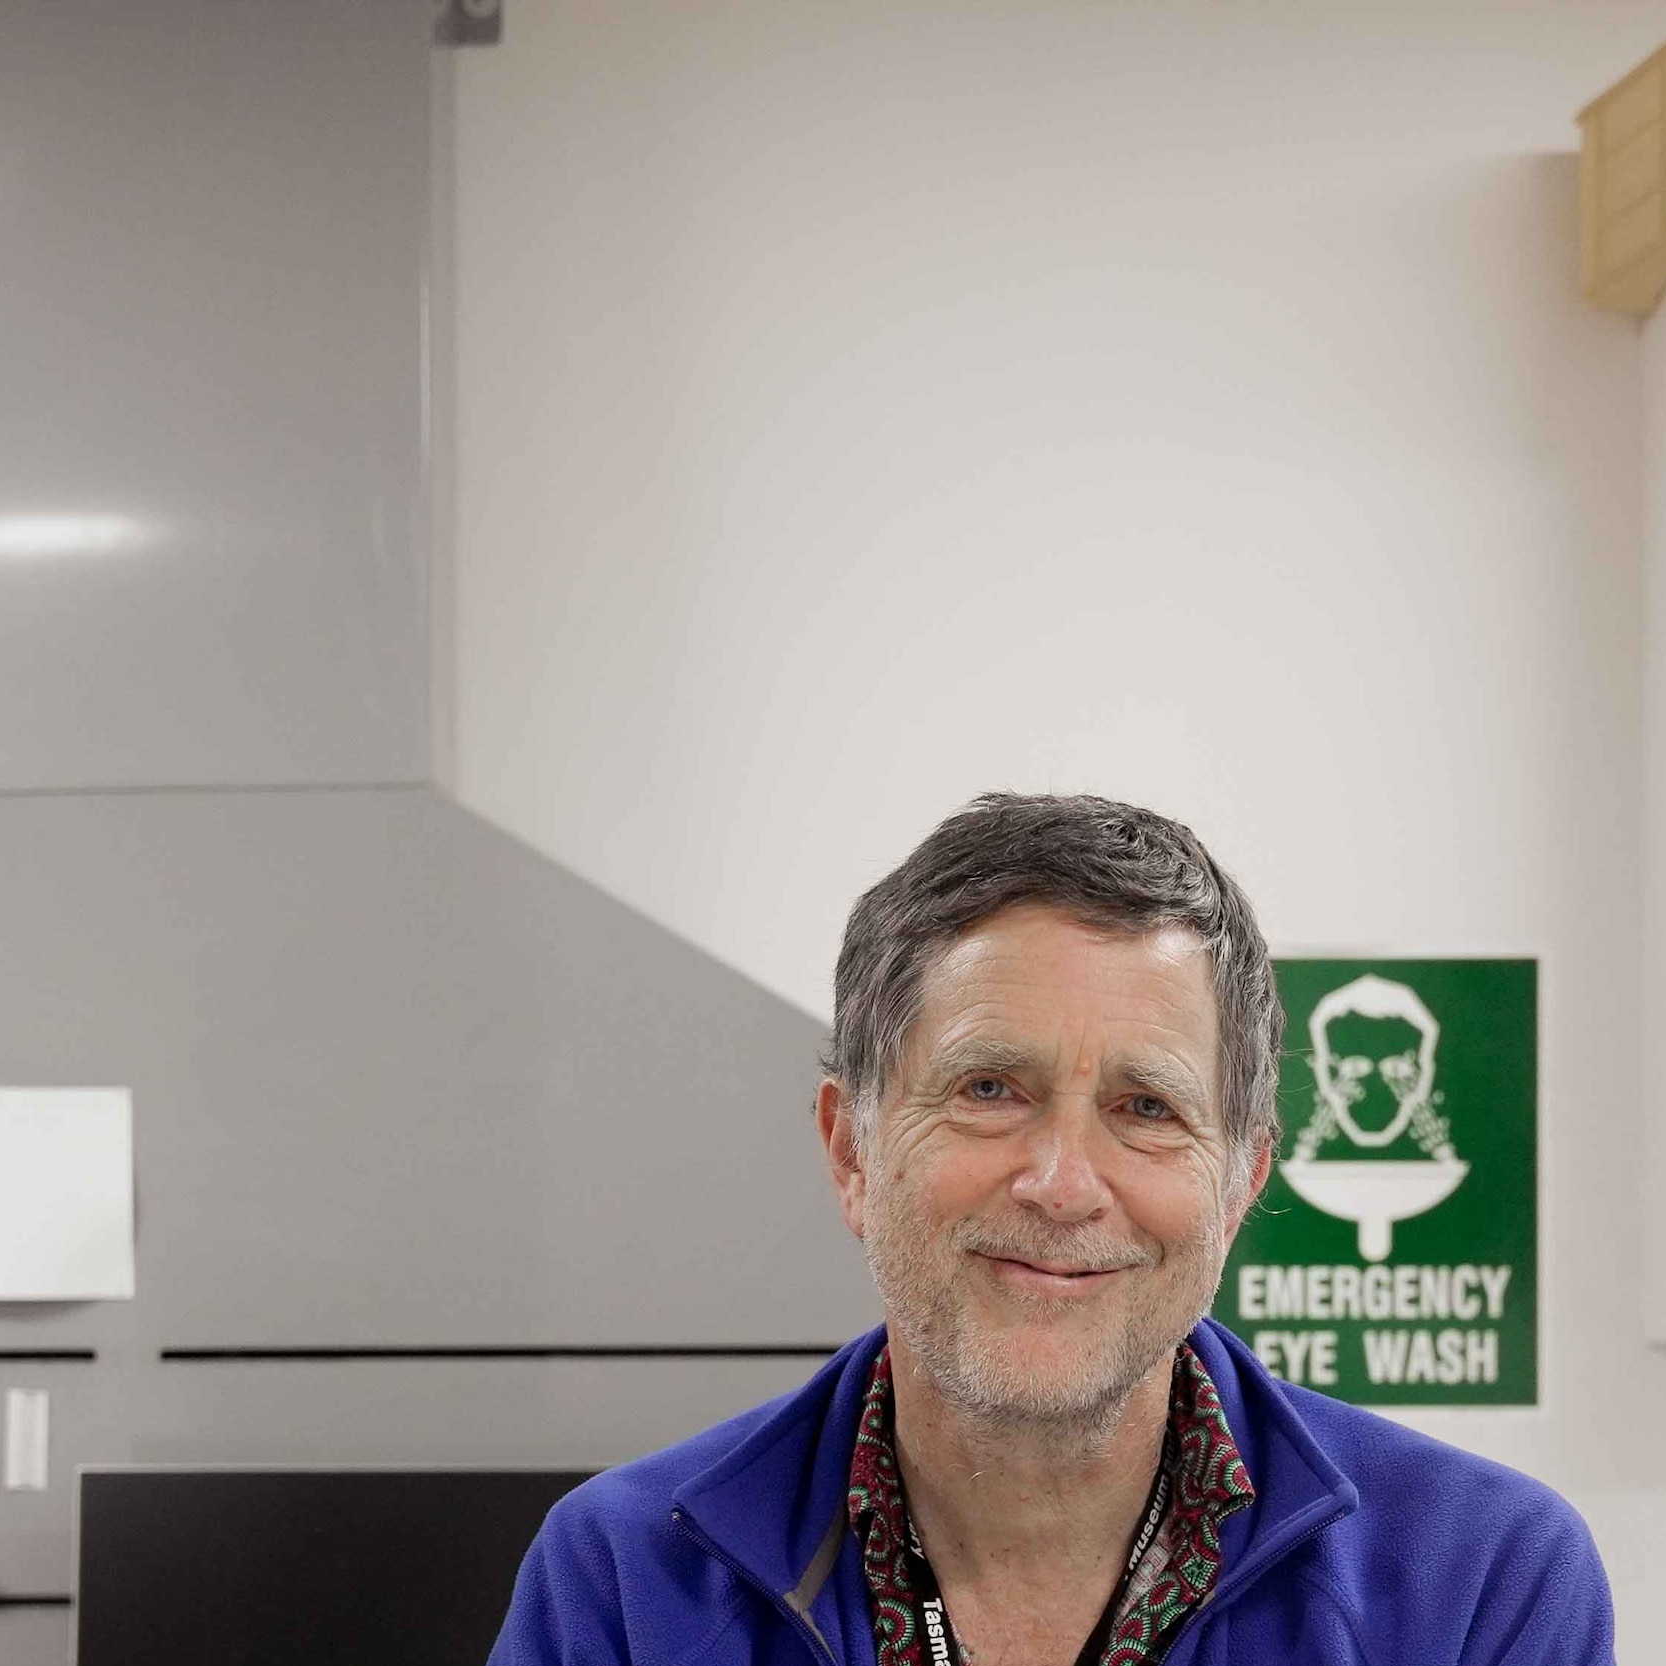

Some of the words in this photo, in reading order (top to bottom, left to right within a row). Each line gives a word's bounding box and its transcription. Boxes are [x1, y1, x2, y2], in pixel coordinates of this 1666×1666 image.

[1237, 1264, 1511, 1321] EMERGENCY
[1254, 1329, 1339, 1385] EYE
[1362, 1328, 1499, 1386] WASH
